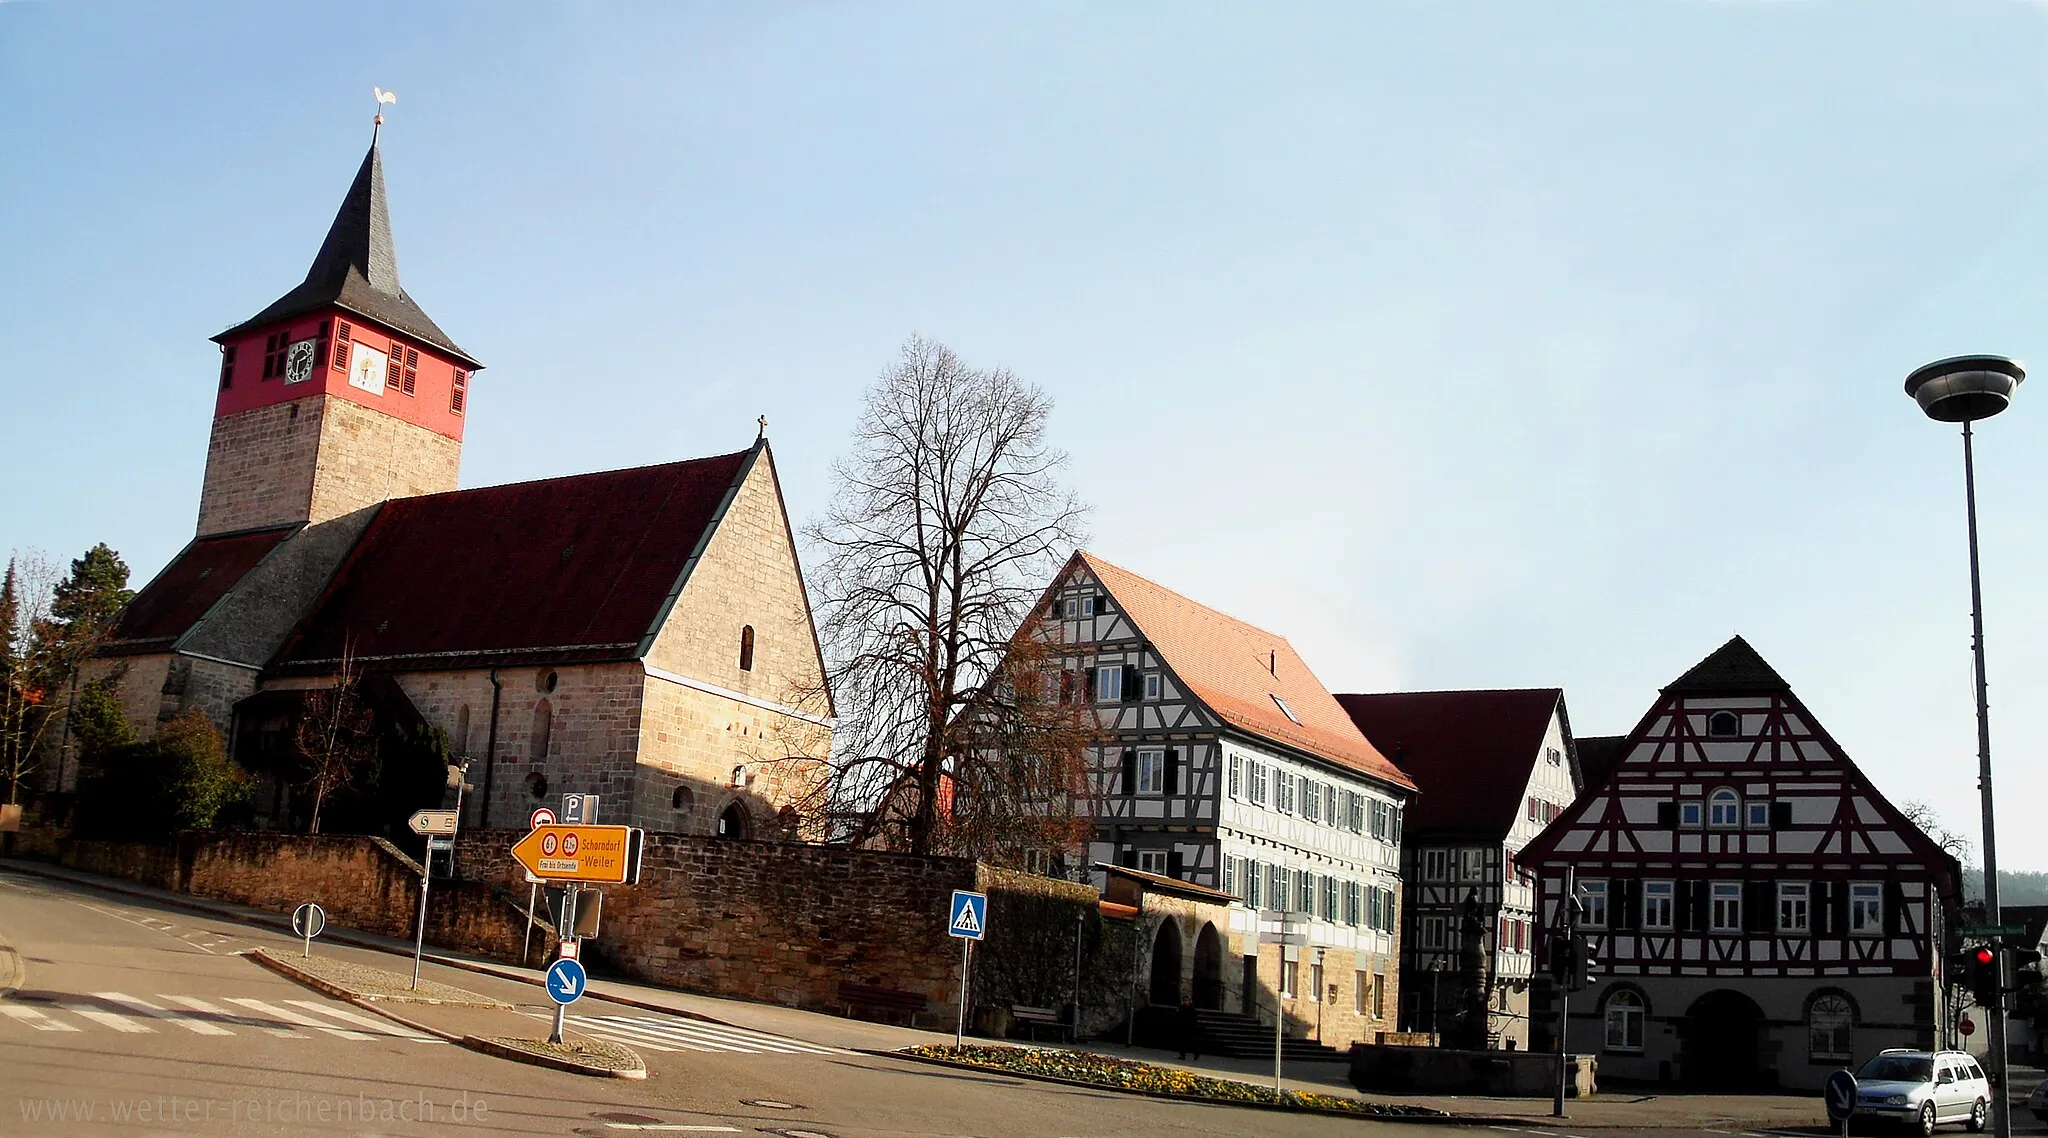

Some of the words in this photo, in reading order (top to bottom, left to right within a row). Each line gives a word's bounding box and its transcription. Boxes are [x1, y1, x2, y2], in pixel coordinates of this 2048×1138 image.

[568, 798, 578, 814] P
[421, 816, 429, 828] S
[581, 839, 620, 852] Schorndorf
[557, 861, 576, 870] Ortsende
[580, 856, 615, 868] -Weiler
